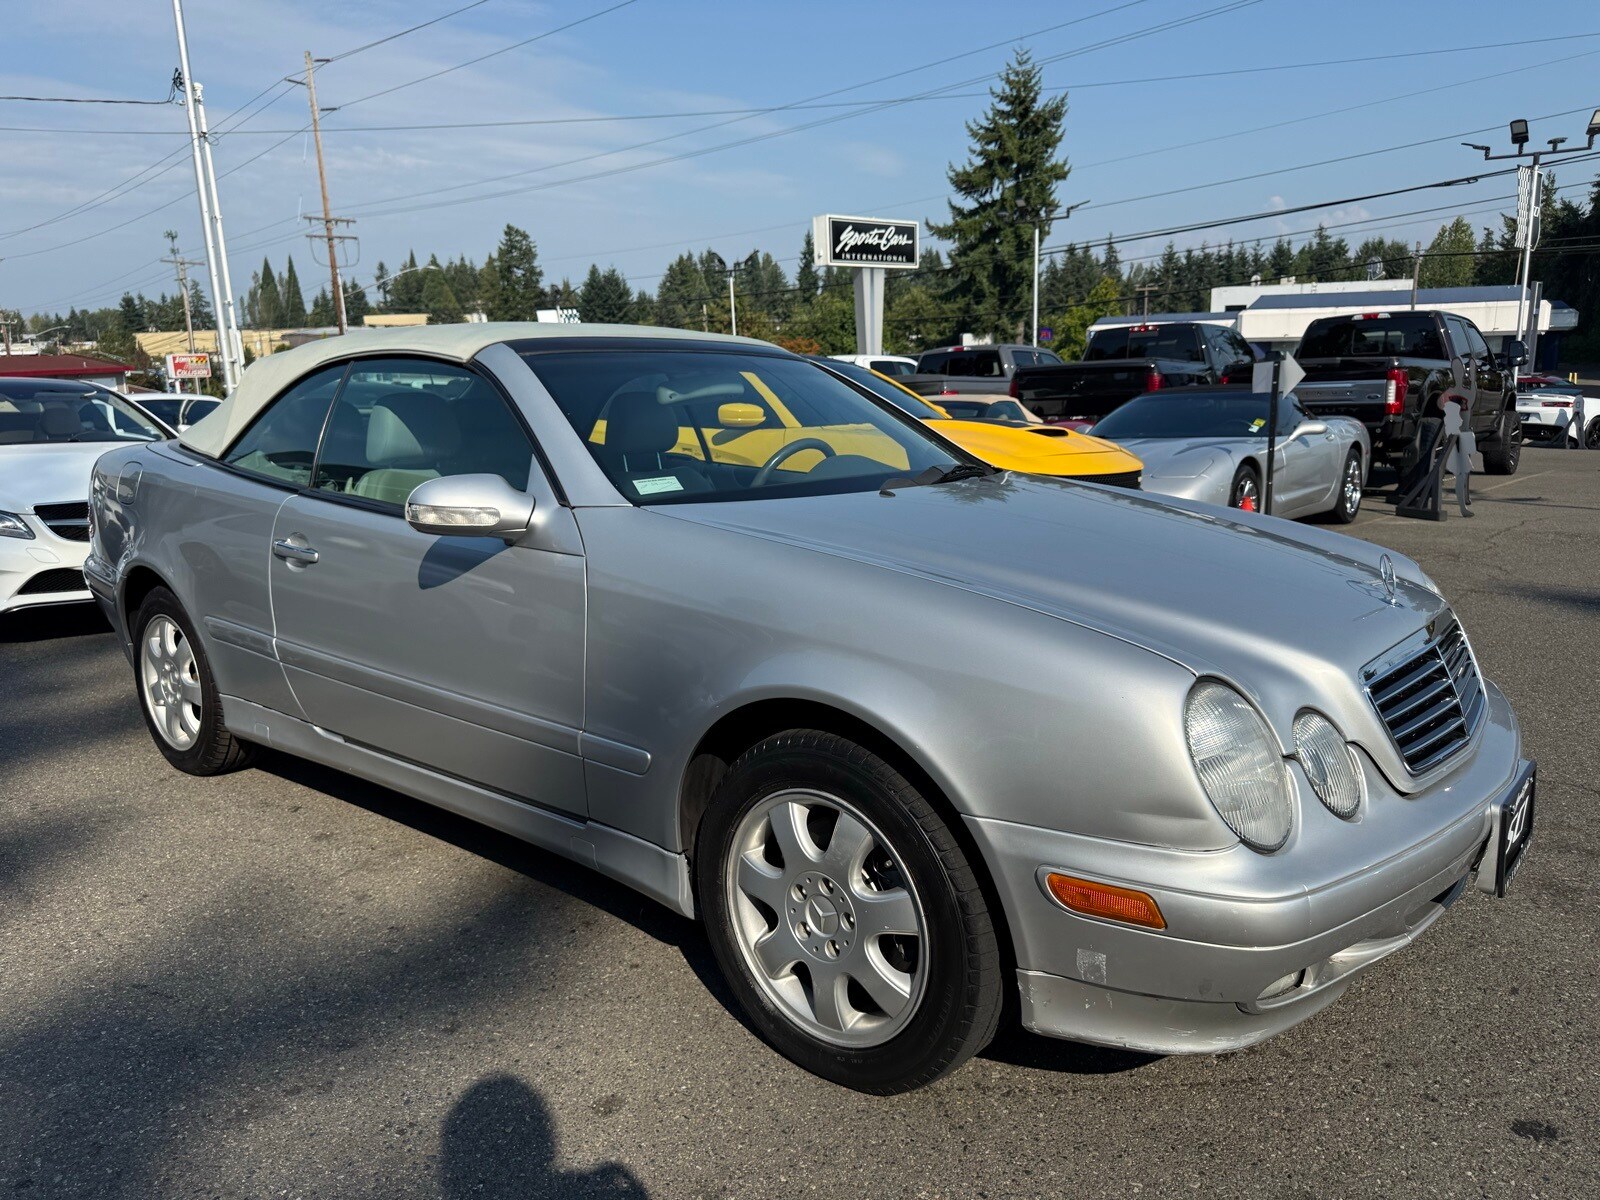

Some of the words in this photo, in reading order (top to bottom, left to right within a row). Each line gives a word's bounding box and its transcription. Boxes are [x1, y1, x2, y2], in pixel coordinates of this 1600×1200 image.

[835, 225, 884, 253] Sports
[880, 225, 912, 251] Cars
[841, 253, 906, 262] INTERNATIONAL
